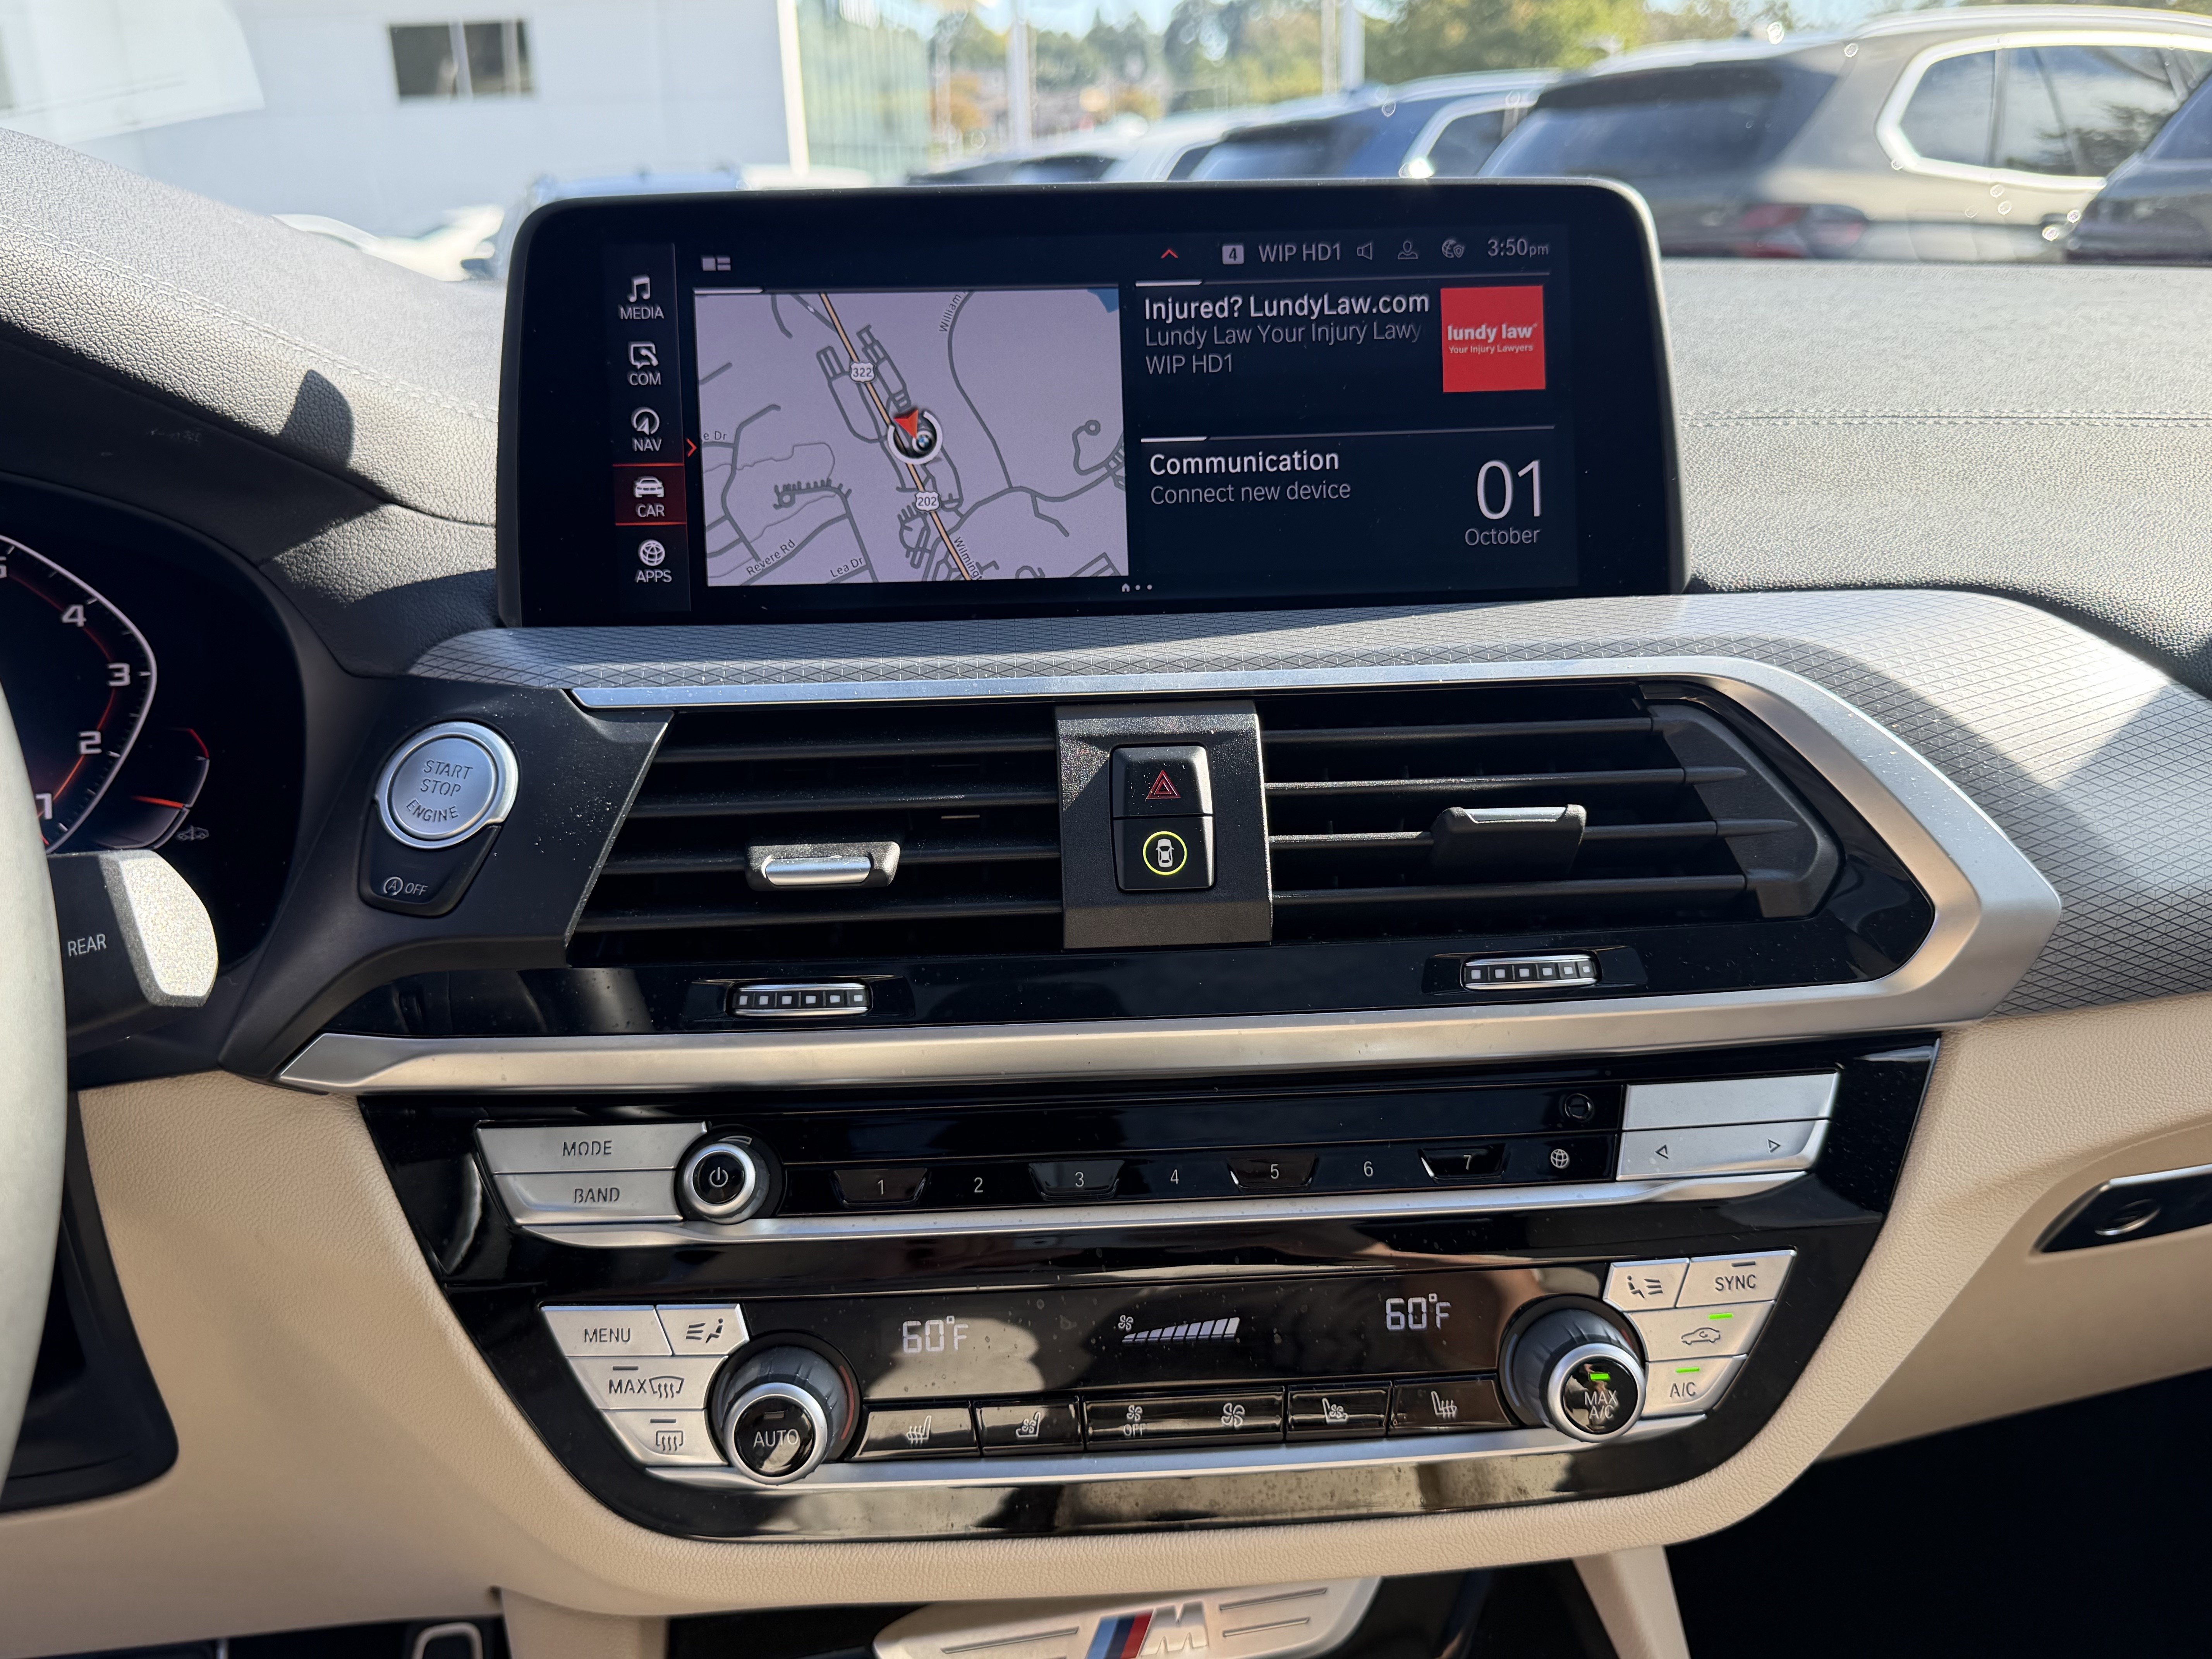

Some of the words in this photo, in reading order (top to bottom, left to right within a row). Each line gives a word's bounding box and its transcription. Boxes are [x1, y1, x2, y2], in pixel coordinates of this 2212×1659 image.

[1228, 248, 1237, 261] 4
[1259, 244, 1296, 263] WIP
[1303, 242, 1341, 262] HD1
[1488, 239, 1549, 258] 3:50pm
[619, 306, 664, 320] MEDIA
[939, 294, 962, 332] William
[1145, 296, 1242, 324] Injured?
[1250, 293, 1429, 320] LundyLaw.com
[1146, 325, 1207, 349] Lundy
[1214, 326, 1252, 345] Law
[1258, 324, 1305, 343] Your
[1312, 321, 1368, 345] Injury
[1374, 321, 1421, 342] Lawy
[1448, 325, 1497, 343] lundy
[1501, 324, 1533, 339] law
[1449, 346, 1468, 354] Your
[1470, 345, 1495, 355] Injury
[1497, 345, 1534, 354] Lawyers
[853, 368, 872, 378] 322
[1146, 355, 1185, 374] WIP
[1193, 354, 1232, 373] HD1
[628, 372, 661, 386] COM
[632, 438, 662, 452] NAV
[714, 431, 727, 440] Dr
[1150, 450, 1340, 476] Communication
[1151, 484, 1234, 505] Connect
[1241, 484, 1280, 502] new
[1286, 479, 1352, 500] device
[1476, 459, 1542, 520] 01
[918, 496, 937, 507] 202
[636, 505, 665, 518] CAR
[1465, 527, 1540, 546] October
[746, 551, 781, 575] Revere
[780, 539, 796, 554] Rd
[636, 570, 672, 583] APPS
[830, 564, 849, 577] Lea
[850, 558, 863, 568] Dr
[62, 605, 87, 627] 4
[107, 663, 131, 687] 3
[79, 730, 102, 754] 2
[423, 760, 473, 780] START
[420, 778, 461, 797] STOP
[36, 793, 53, 820] 1
[406, 799, 459, 823] ENGINE
[405, 883, 428, 895] OFF
[68, 934, 107, 958] REAR
[562, 1140, 612, 1157] MODE
[877, 1179, 884, 1195] 1
[974, 1177, 984, 1194] 2
[1075, 1171, 1085, 1188] 3
[1170, 1168, 1179, 1185] 4
[1270, 1163, 1279, 1180] 5
[1363, 1161, 1374, 1178] 6
[1463, 1154, 1472, 1170] 7
[574, 1187, 620, 1204] BAND
[1715, 1274, 1757, 1292] SYNC
[1386, 1293, 1451, 1331] 60°F
[584, 1328, 631, 1343] MENU
[902, 1316, 969, 1353] 60°F
[609, 1379, 647, 1395] MAX
[1669, 1382, 1696, 1398] A/C
[1584, 1389, 1618, 1406] MAX
[1589, 1405, 1614, 1419] A/C
[753, 1428, 800, 1448] AUTO
[1123, 1423, 1147, 1437] OFF
